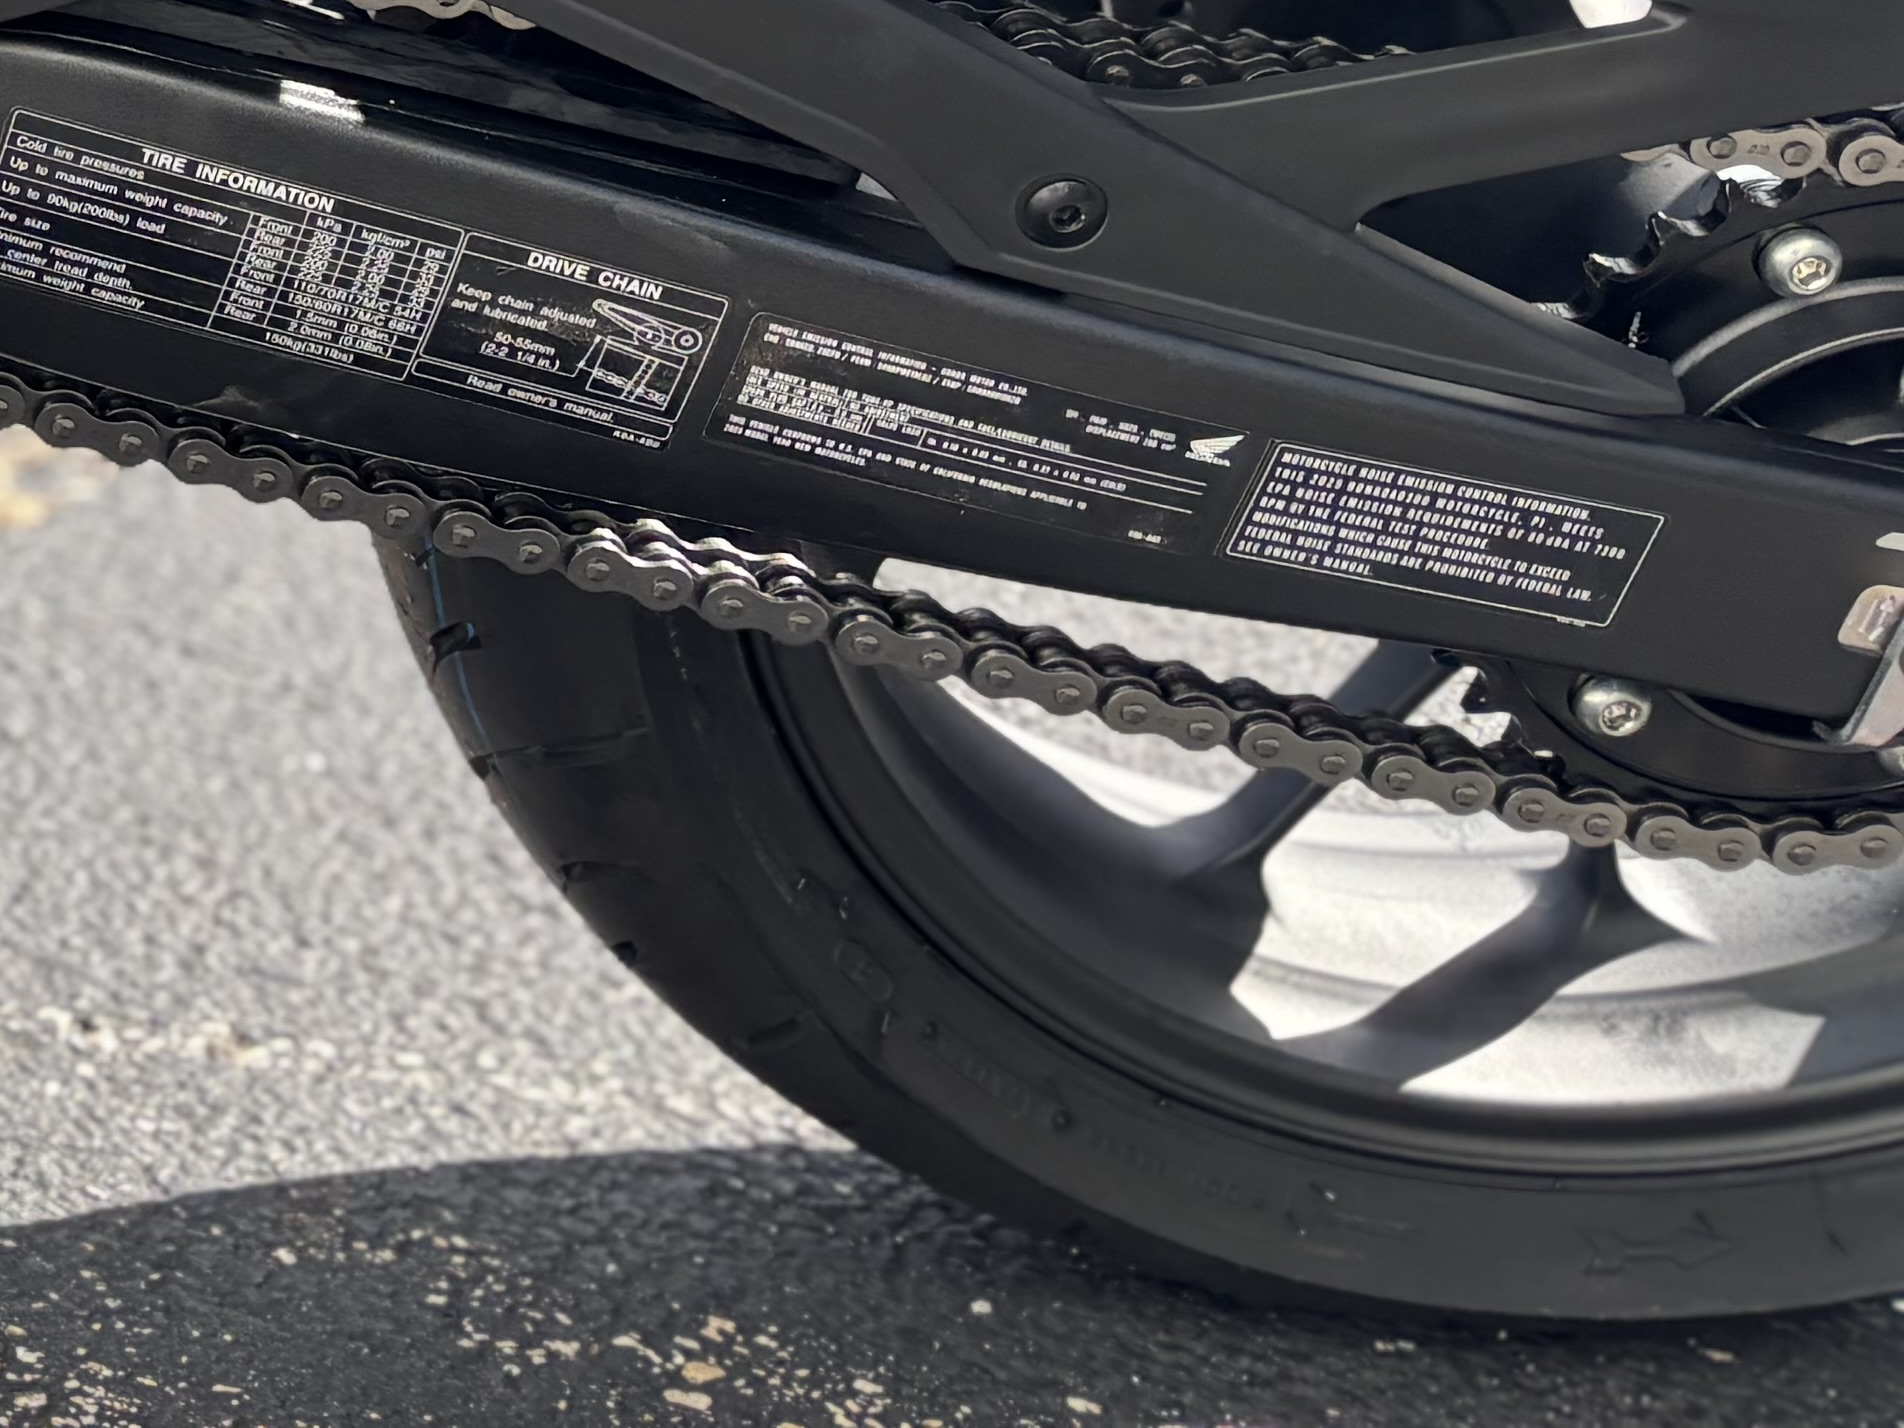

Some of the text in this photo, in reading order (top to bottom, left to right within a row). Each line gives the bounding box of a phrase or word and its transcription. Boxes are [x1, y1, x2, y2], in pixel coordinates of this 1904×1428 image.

[15, 135, 146, 182] Cold tire pressures
[137, 147, 336, 213] TIRE INFORMATION
[7, 157, 228, 225] Up to maximum weight capacity
[0, 180, 21, 196] Up
[25, 187, 41, 201] to
[135, 216, 166, 234] load
[23, 214, 52, 231] size
[257, 216, 293, 235] Front
[315, 216, 343, 233] kPa
[48, 243, 127, 272] recommend
[248, 240, 284, 260] Front
[5, 246, 48, 267] center
[53, 259, 88, 277] tread
[239, 265, 275, 283] Front
[526, 251, 664, 300] DRIVE CHAIN
[41, 271, 85, 294] weight
[89, 285, 146, 310] capacity
[234, 278, 268, 296] Rear
[228, 291, 264, 309] Front
[450, 296, 478, 312] and
[455, 282, 596, 330] Keep chain adjusted
[223, 304, 257, 321] Rear
[465, 375, 503, 393] Read
